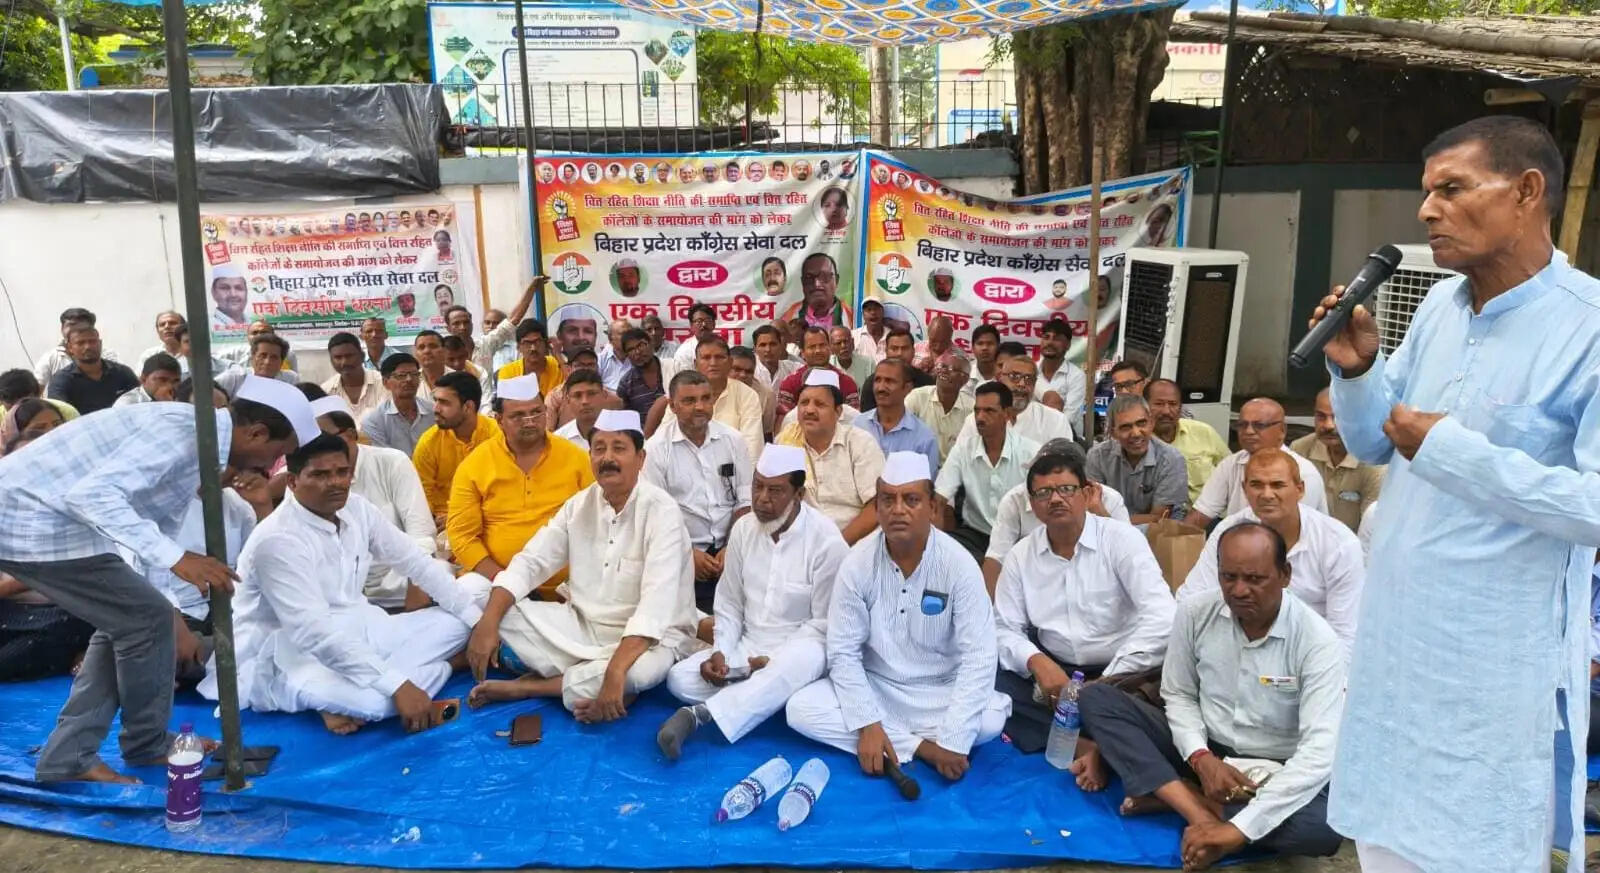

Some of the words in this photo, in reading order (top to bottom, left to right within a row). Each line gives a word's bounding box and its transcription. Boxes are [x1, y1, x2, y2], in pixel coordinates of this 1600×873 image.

[607, 194, 629, 206] रहित
[663, 193, 685, 206] नीति
[690, 193, 703, 206] की
[708, 192, 741, 206] समाप्ति
[745, 192, 761, 205] एवं
[785, 191, 807, 204] रहित
[642, 213, 653, 226] के
[656, 213, 705, 226] समायोजन
[708, 212, 722, 225] की
[726, 212, 746, 225] मांग
[749, 211, 764, 225] को
[767, 211, 792, 225] लेकर
[251, 242, 272, 254] रहित
[323, 241, 336, 251] की
[373, 236, 387, 251] एवं
[409, 235, 433, 248] रहित
[594, 232, 640, 252] बिहार
[642, 231, 682, 254] प्रदेश
[743, 231, 775, 250] सेवा
[779, 234, 808, 250] दल
[1032, 236, 1046, 247] की
[1052, 236, 1070, 248] मांग
[1073, 235, 1088, 248] को
[1099, 236, 1118, 247] कर
[283, 257, 292, 269] के
[295, 256, 340, 269] समायोजन
[342, 255, 355, 267] की
[357, 254, 377, 266] मांग
[379, 253, 393, 265] को
[394, 252, 418, 264] लेकर
[917, 239, 961, 262] बिहार
[963, 249, 1002, 267] प्रदेश
[1064, 254, 1091, 271] सेव
[269, 275, 304, 291] बिहार
[308, 273, 340, 289] प्रदेश
[386, 270, 414, 285] सेवा
[417, 271, 440, 283] दल
[677, 266, 719, 283] द्वारा
[984, 282, 1026, 298] द्वारा
[252, 302, 280, 315] एक
[282, 295, 346, 317] दिवसीय
[608, 303, 660, 321] एक
[667, 294, 777, 321] दिसीय
